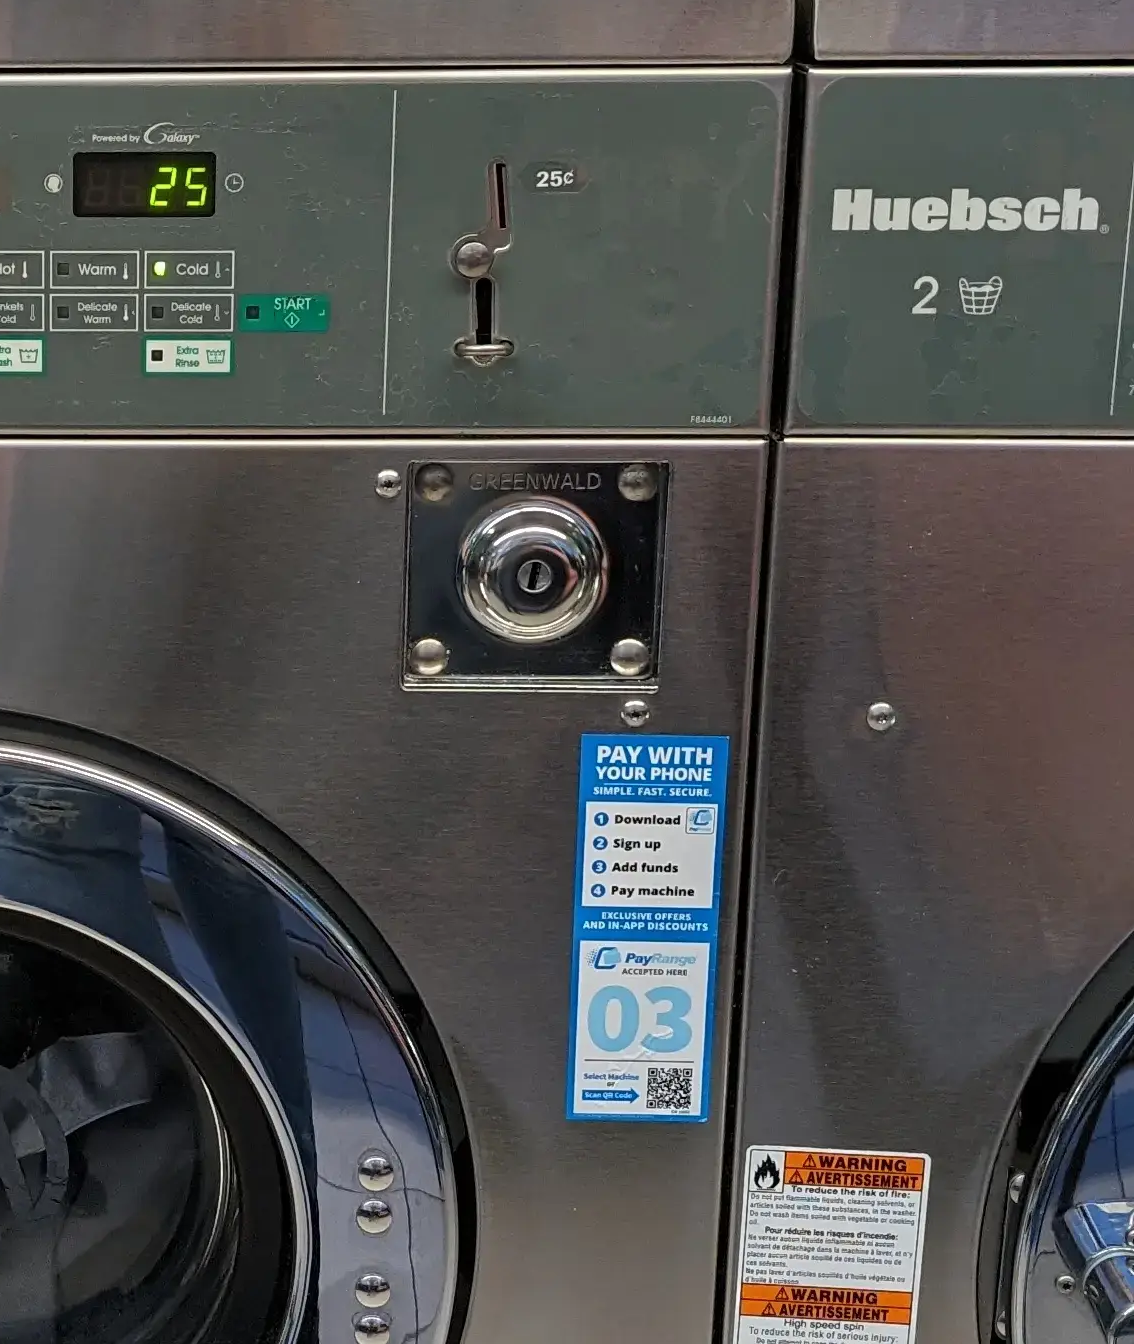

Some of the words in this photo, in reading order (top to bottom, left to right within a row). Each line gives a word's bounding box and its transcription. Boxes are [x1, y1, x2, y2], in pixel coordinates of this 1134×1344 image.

[92, 134, 127, 142] Powered
[129, 134, 140, 143] by
[144, 122, 194, 145] Galaxy
[536, 168, 574, 188] 25¢
[150, 167, 207, 206] 25
[832, 188, 1099, 231] Huebsch
[78, 264, 116, 276] Warm
[176, 263, 209, 276] Cold
[912, 275, 939, 314] 2
[77, 302, 117, 312] Delicate
[171, 302, 212, 312] Delicate
[274, 298, 311, 310] START
[84, 314, 111, 324] Warm
[180, 314, 203, 324] Cold
[176, 346, 199, 355] Extra
[175, 358, 200, 368] Rinse
[469, 472, 602, 491] GREENWALD
[596, 745, 642, 764] PAY
[648, 746, 712, 765] WITH
[595, 766, 646, 781] YOUR
[650, 767, 712, 781] PHONE
[593, 787, 635, 796] SIMPLE.
[638, 787, 666, 796] FAST.
[669, 788, 712, 797] SECURE.
[615, 815, 680, 825] Download
[613, 839, 640, 851] Sign
[645, 840, 661, 851] up
[612, 862, 637, 872] Add
[641, 862, 679, 873] funds
[611, 886, 635, 898] Pay
[638, 886, 695, 896] machine
[602, 912, 652, 920] EXCLUSIVE
[654, 913, 691, 921] OFFERS
[583, 921, 605, 929] AND
[608, 921, 645, 930] IN-APP
[648, 922, 708, 931] DISCOUNTS
[625, 953, 696, 967] PayRange
[622, 968, 664, 976] ACCEPTED
[666, 968, 687, 976] HERE
[587, 985, 693, 1053] 03
[819, 1157, 907, 1172] WARNING
[807, 1172, 918, 1189] AVERTISSEMENT
[792, 1185, 802, 1193] To
[805, 1186, 838, 1195] reduce
[841, 1187, 856, 1195] the
[858, 1188, 877, 1197] risk
[879, 1189, 889, 1197] of
[891, 1190, 910, 1199] fire:
[791, 1289, 878, 1305] WARNING
[779, 1304, 889, 1321] AVERTISSEMENT
